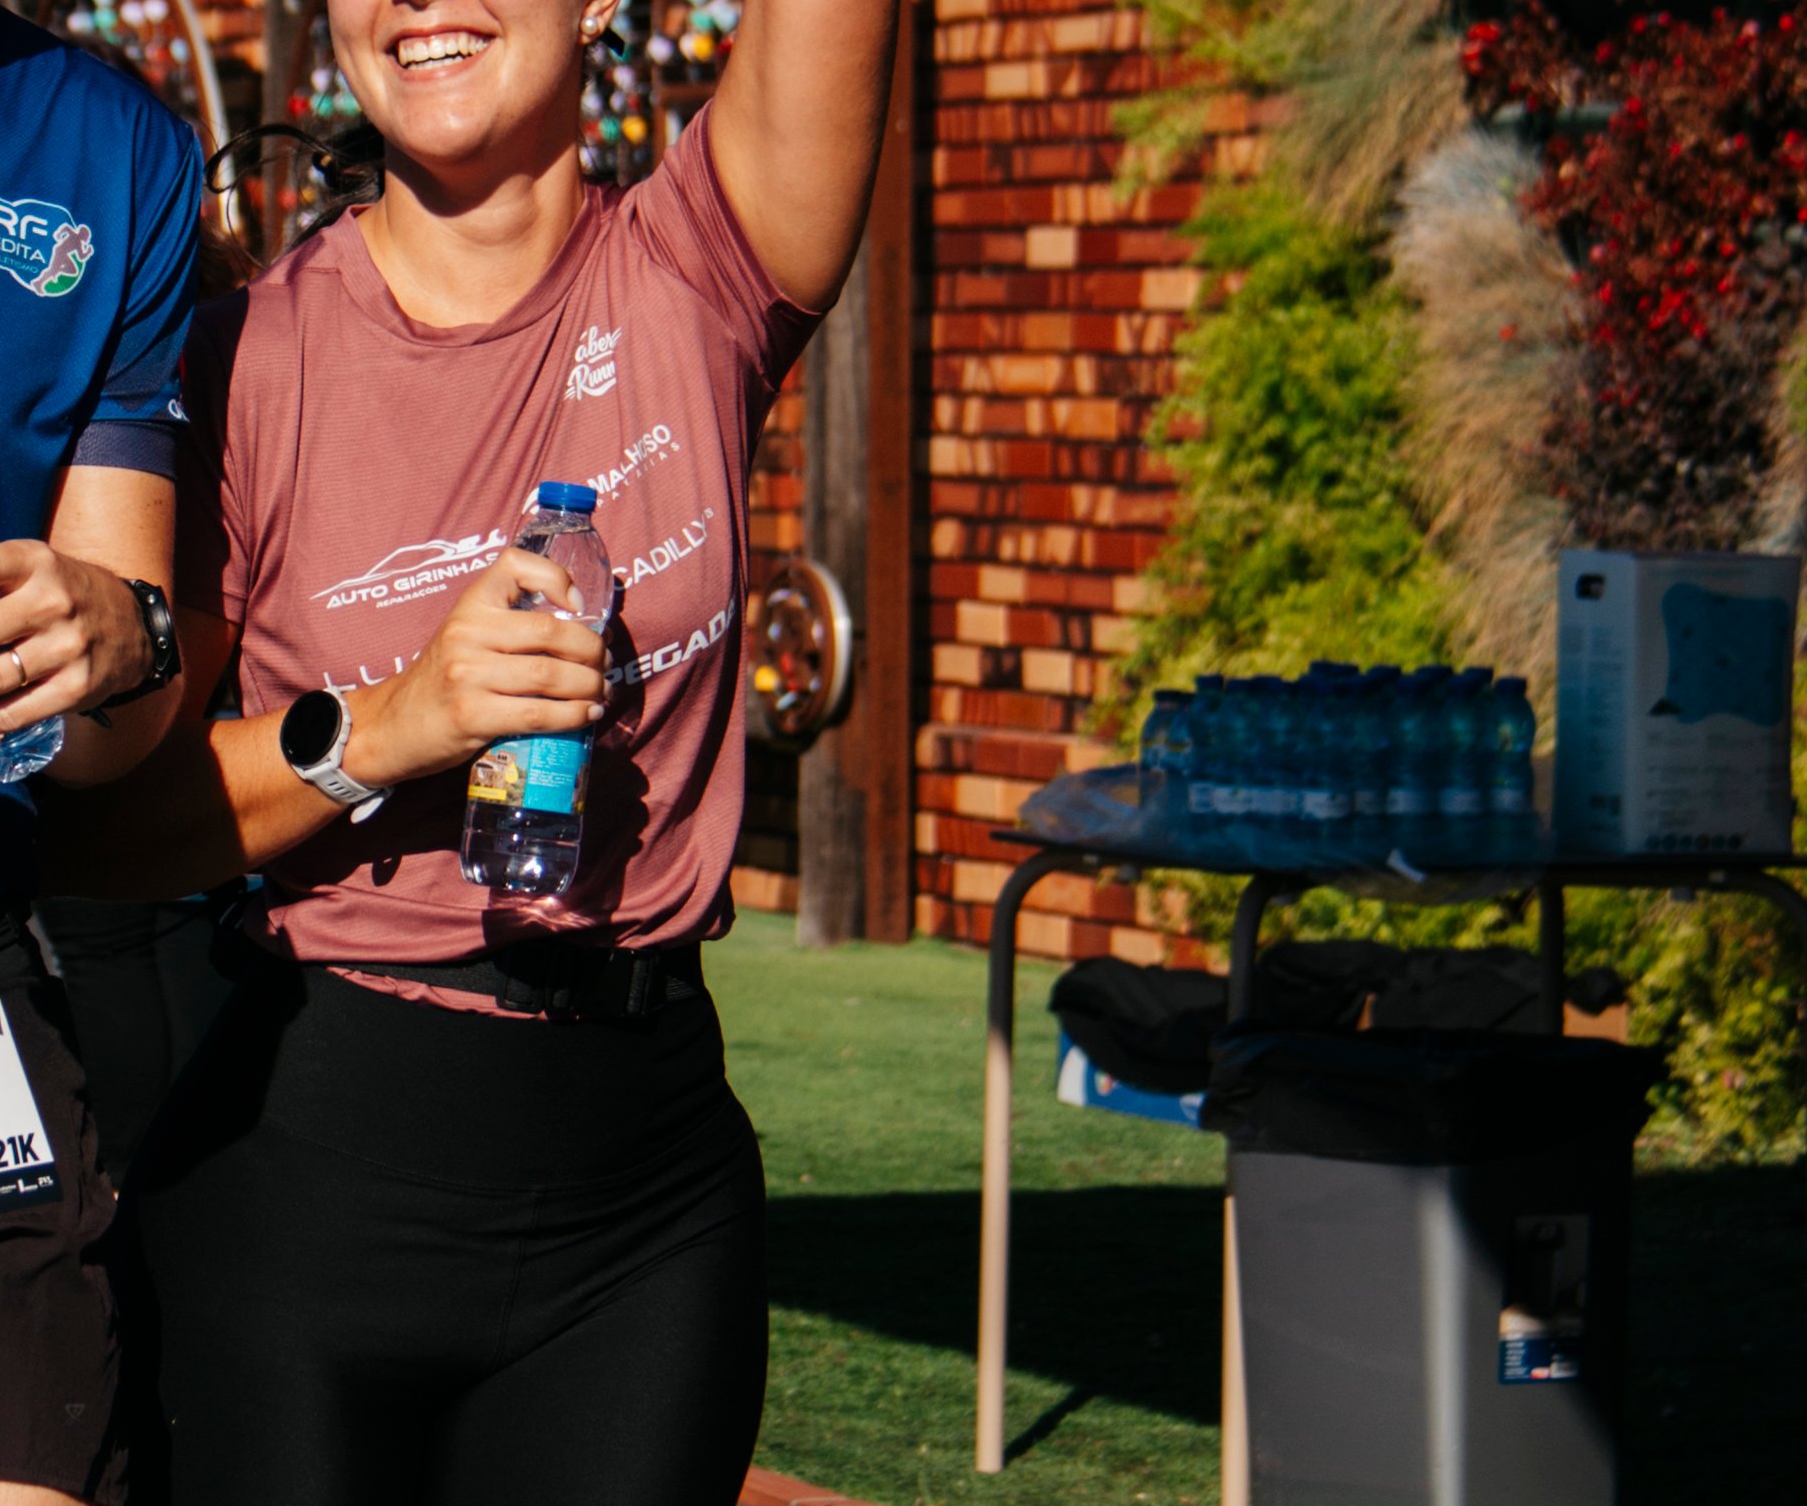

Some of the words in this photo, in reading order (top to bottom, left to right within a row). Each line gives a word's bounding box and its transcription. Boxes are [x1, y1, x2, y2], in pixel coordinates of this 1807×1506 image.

[586, 424, 672, 495] MALHOSO
[611, 515, 708, 590] CADILLY
[325, 584, 389, 610] AUTO
[375, 583, 448, 609] REPARAÇÕES
